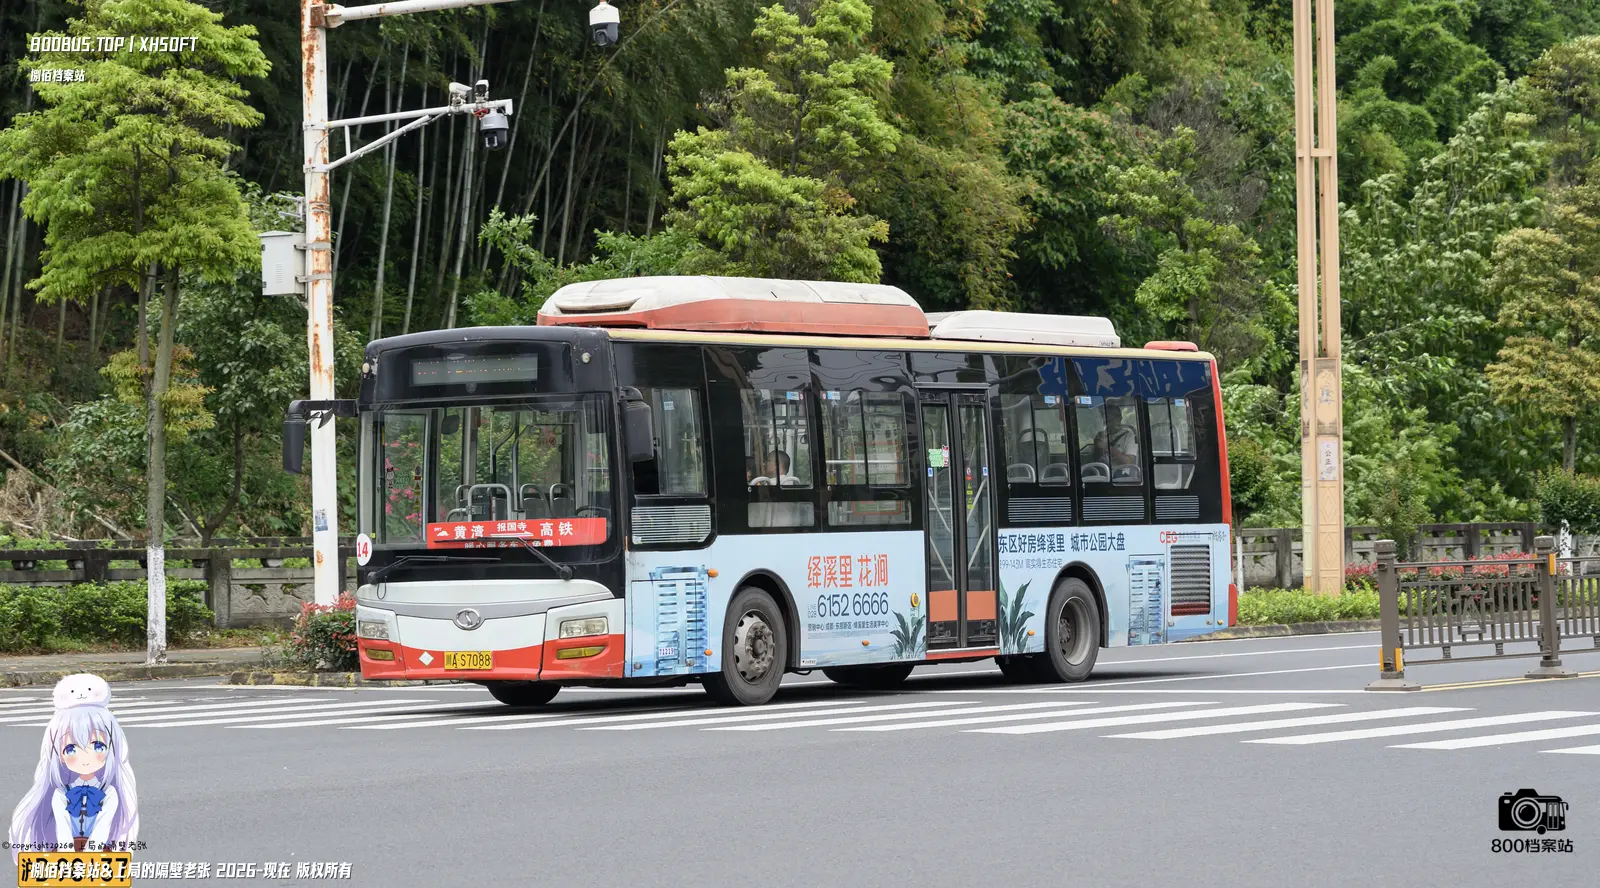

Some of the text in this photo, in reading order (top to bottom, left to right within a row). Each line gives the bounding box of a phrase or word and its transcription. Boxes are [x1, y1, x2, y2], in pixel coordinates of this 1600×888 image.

[453, 524, 485, 540] 黄湾
[496, 521, 528, 533] 报国寺
[539, 521, 574, 537] 高铁
[1160, 530, 1178, 544] CEG
[357, 541, 369, 558] 14
[998, 531, 1126, 554] 东区好房绛溪里 城市公园大盘
[807, 553, 889, 589] 绛溪里 花涧
[817, 591, 889, 618] 6152 6666
